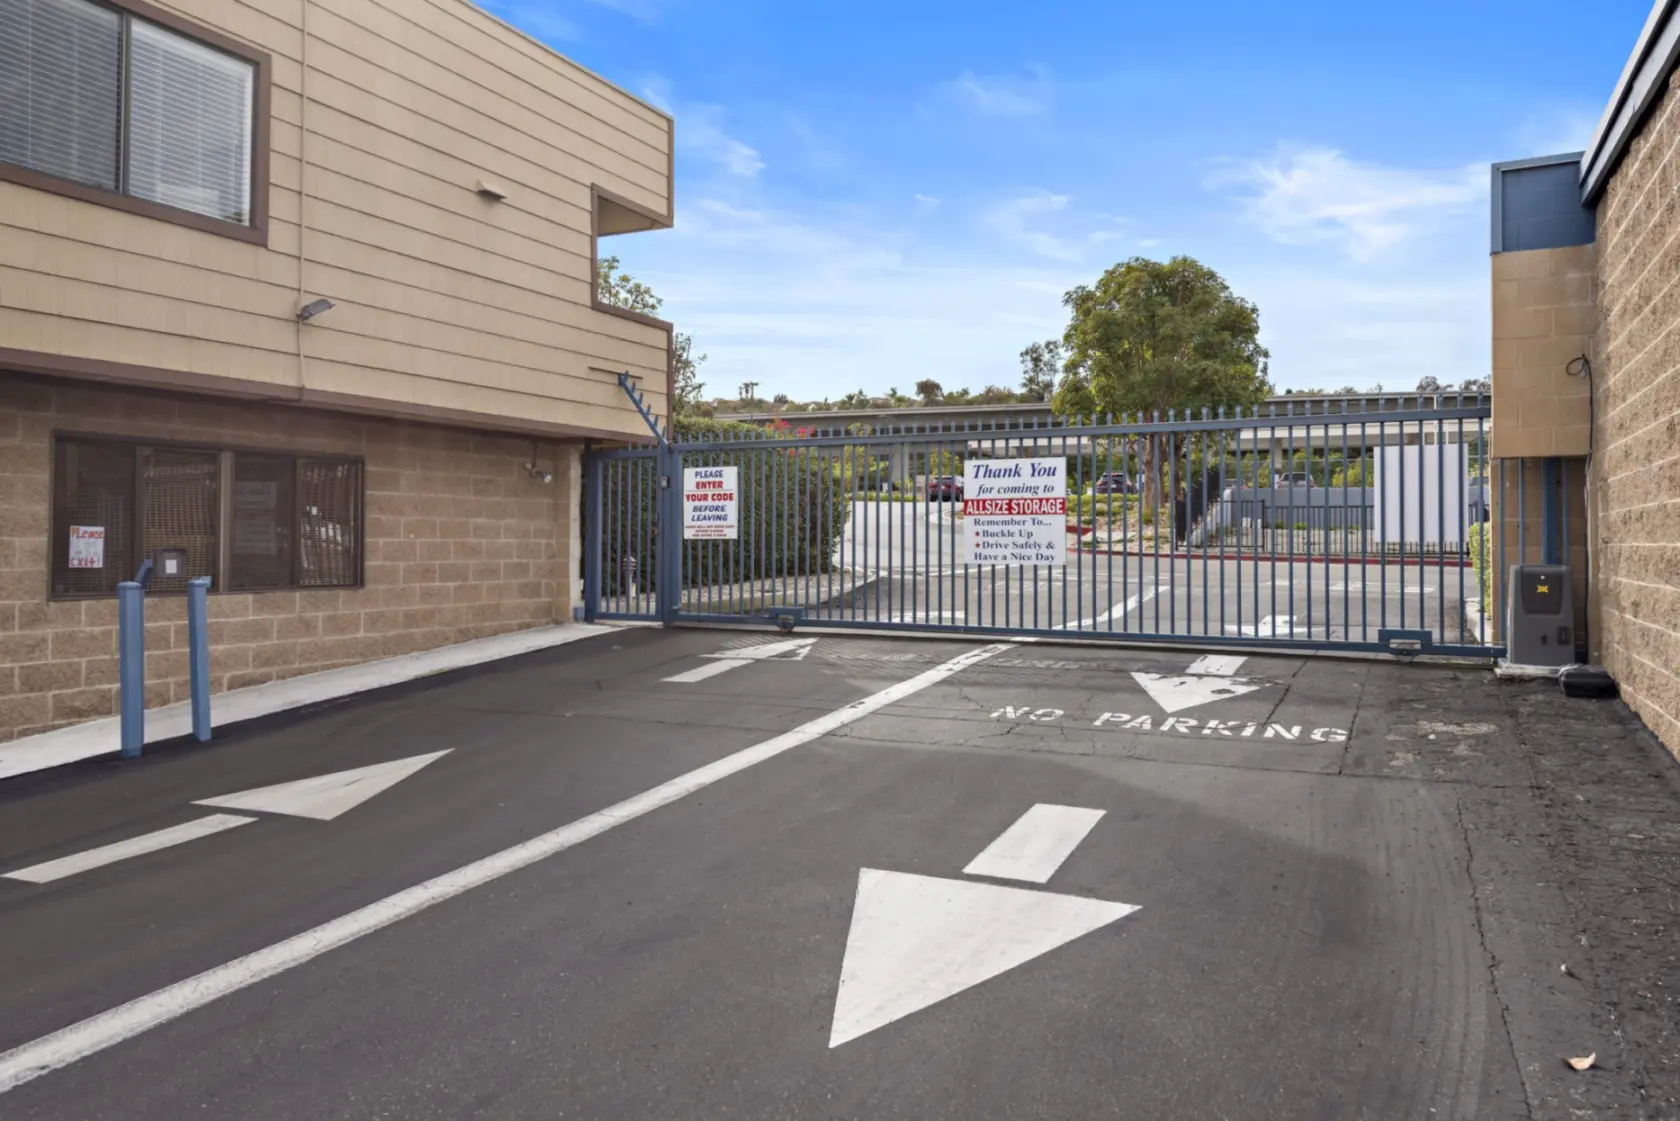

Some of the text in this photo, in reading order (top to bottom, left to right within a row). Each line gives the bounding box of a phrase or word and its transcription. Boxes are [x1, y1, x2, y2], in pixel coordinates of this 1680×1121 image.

[695, 470, 724, 478] PLEASE
[973, 462, 1057, 479] Thank You
[696, 481, 723, 489] ENTER
[976, 483, 1054, 497] for coming to
[686, 493, 734, 502] YOUR CODE
[966, 499, 1063, 514] ALLSIZE STORAGE
[691, 514, 728, 522] LEAVING
[974, 518, 1027, 526] Remember
[1019, 530, 1033, 539] Up
[982, 541, 1055, 551] Drive Safely &
[974, 552, 998, 560] Have
[1010, 552, 1032, 560] Nice
[1035, 553, 1056, 563] Day
[989, 705, 1348, 743] NO PARKING
